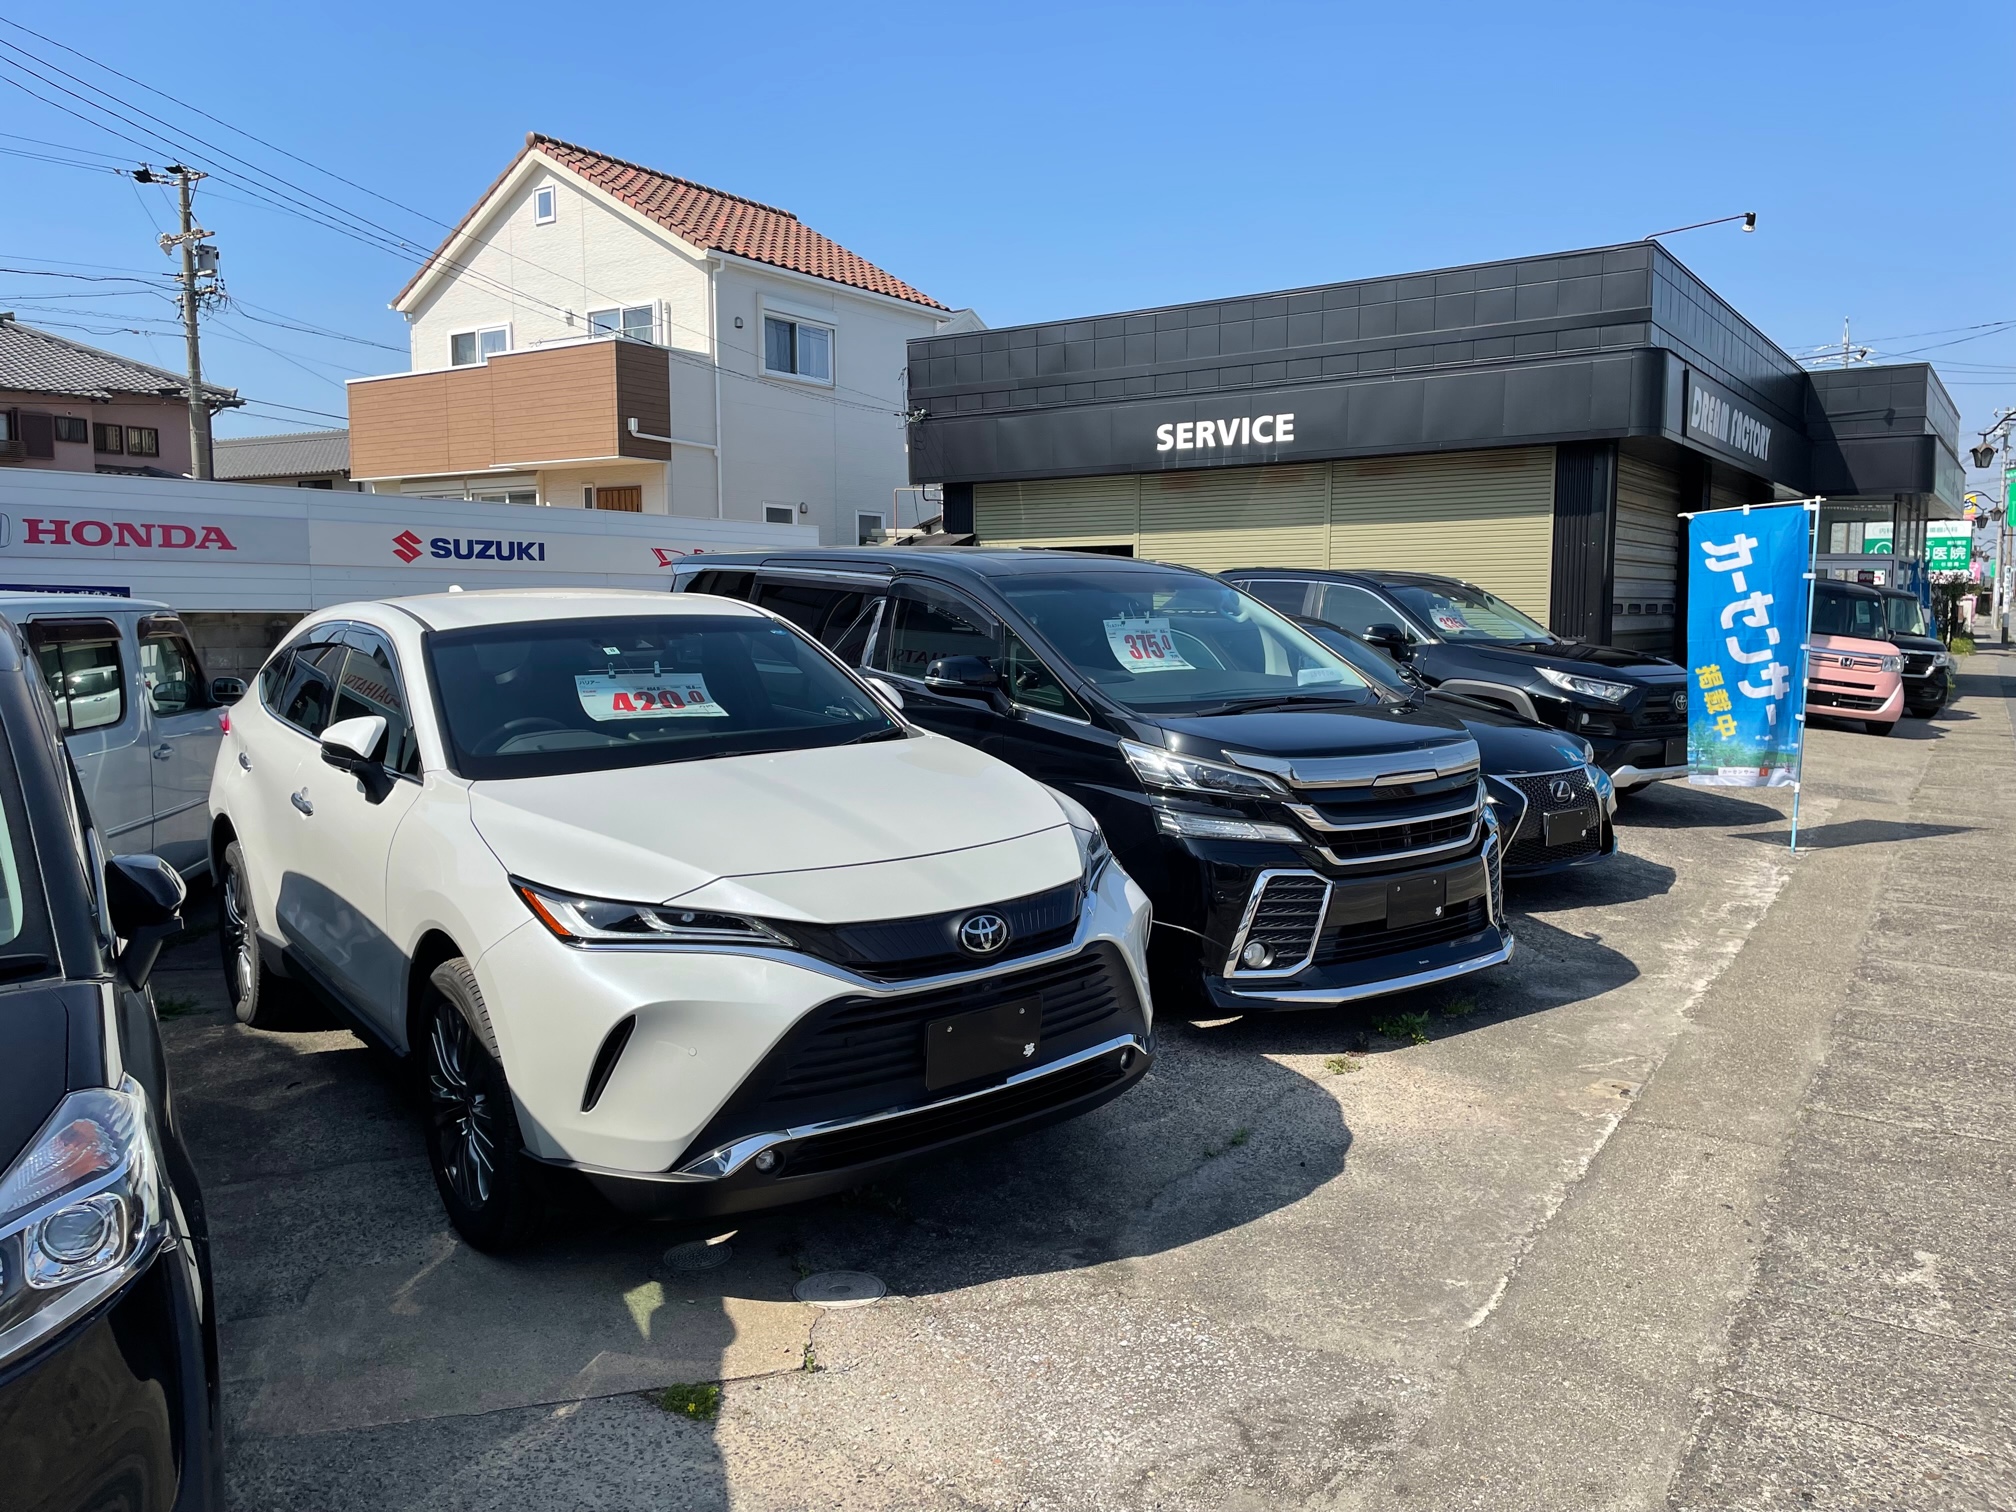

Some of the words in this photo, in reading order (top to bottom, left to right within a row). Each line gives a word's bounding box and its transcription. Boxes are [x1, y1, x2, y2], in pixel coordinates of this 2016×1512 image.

[1156, 413, 1295, 451] SERVICE
[1691, 386, 1730, 443] DREAM
[1730, 408, 1771, 462] FACTORY
[22, 518, 238, 551] HONDA
[430, 537, 545, 562] SUZUKI
[1124, 634, 1172, 659] 375.0
[1700, 533, 1791, 727] カーセンサー
[612, 690, 705, 712] 420.0
